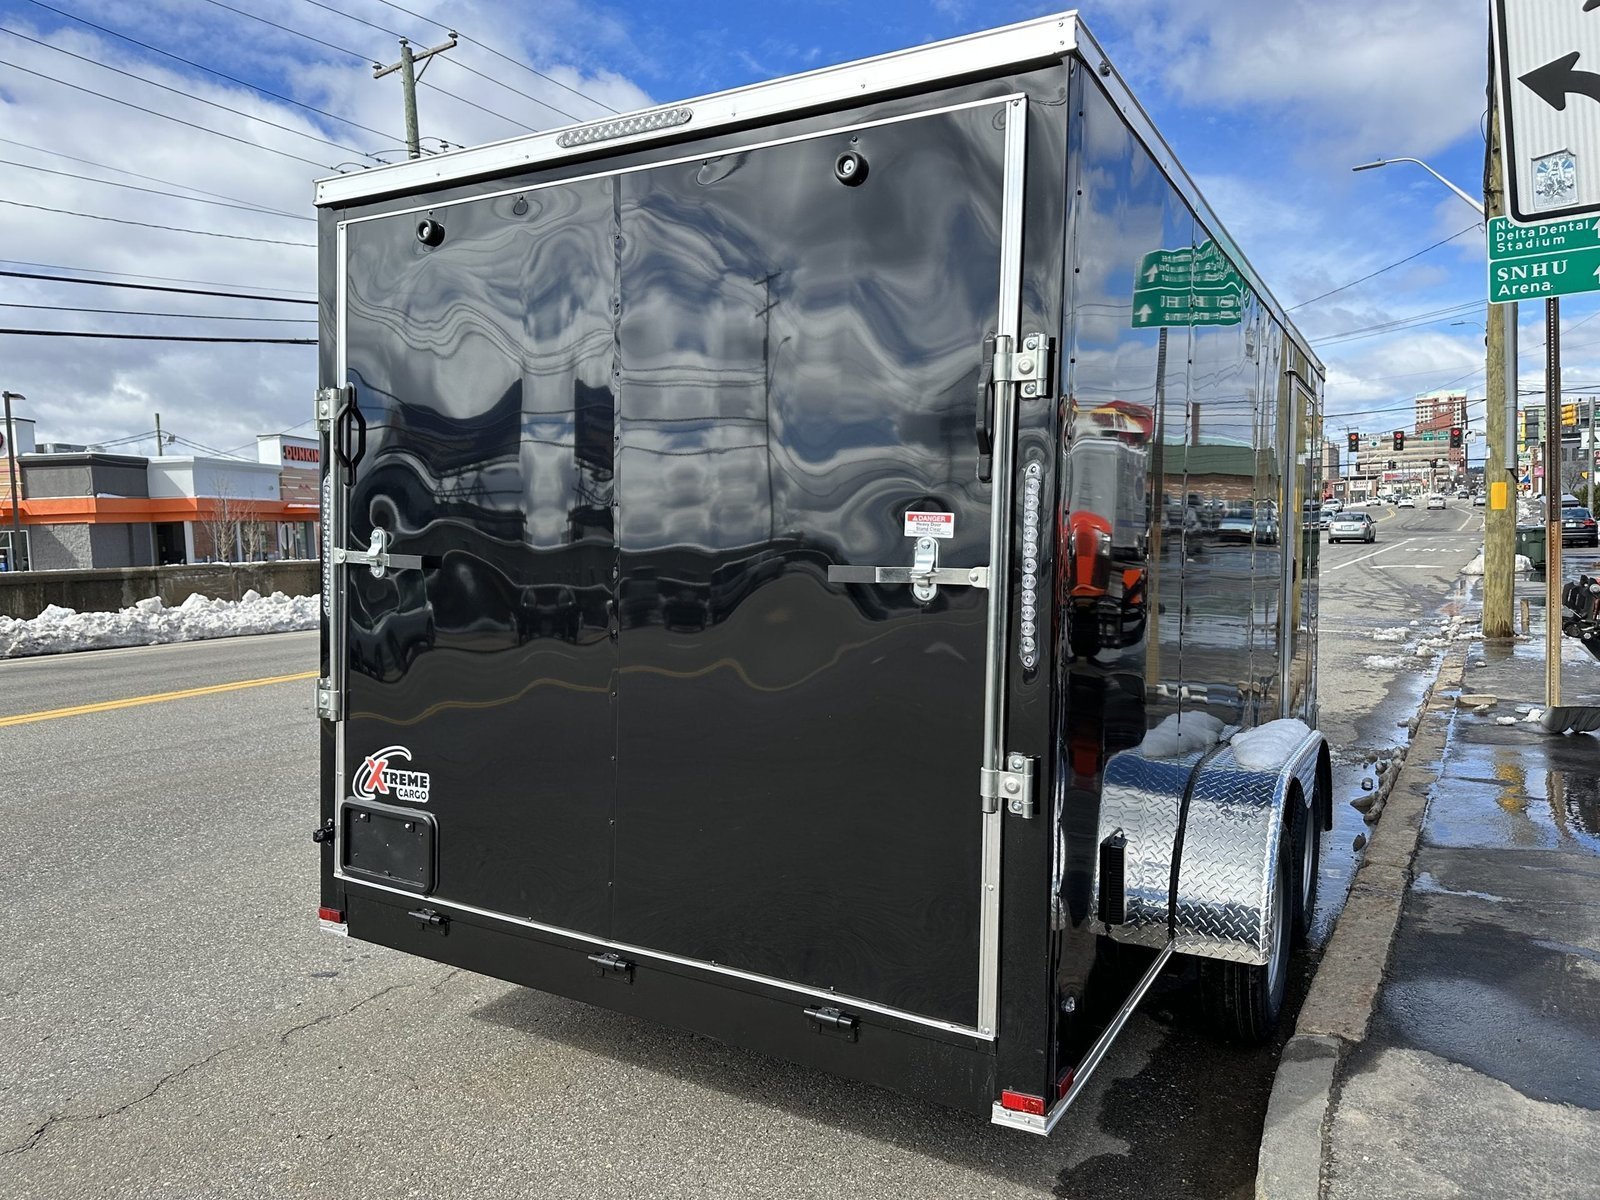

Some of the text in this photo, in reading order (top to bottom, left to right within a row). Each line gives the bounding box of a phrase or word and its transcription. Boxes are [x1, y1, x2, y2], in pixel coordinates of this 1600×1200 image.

[1496, 219, 1589, 242] Delta Dental
[1497, 236, 1566, 252] Stadium
[1497, 259, 1568, 281] SNHU
[1497, 281, 1551, 297] Arena
[918, 515, 946, 523] DANGER
[398, 788, 427, 800] CARGO
